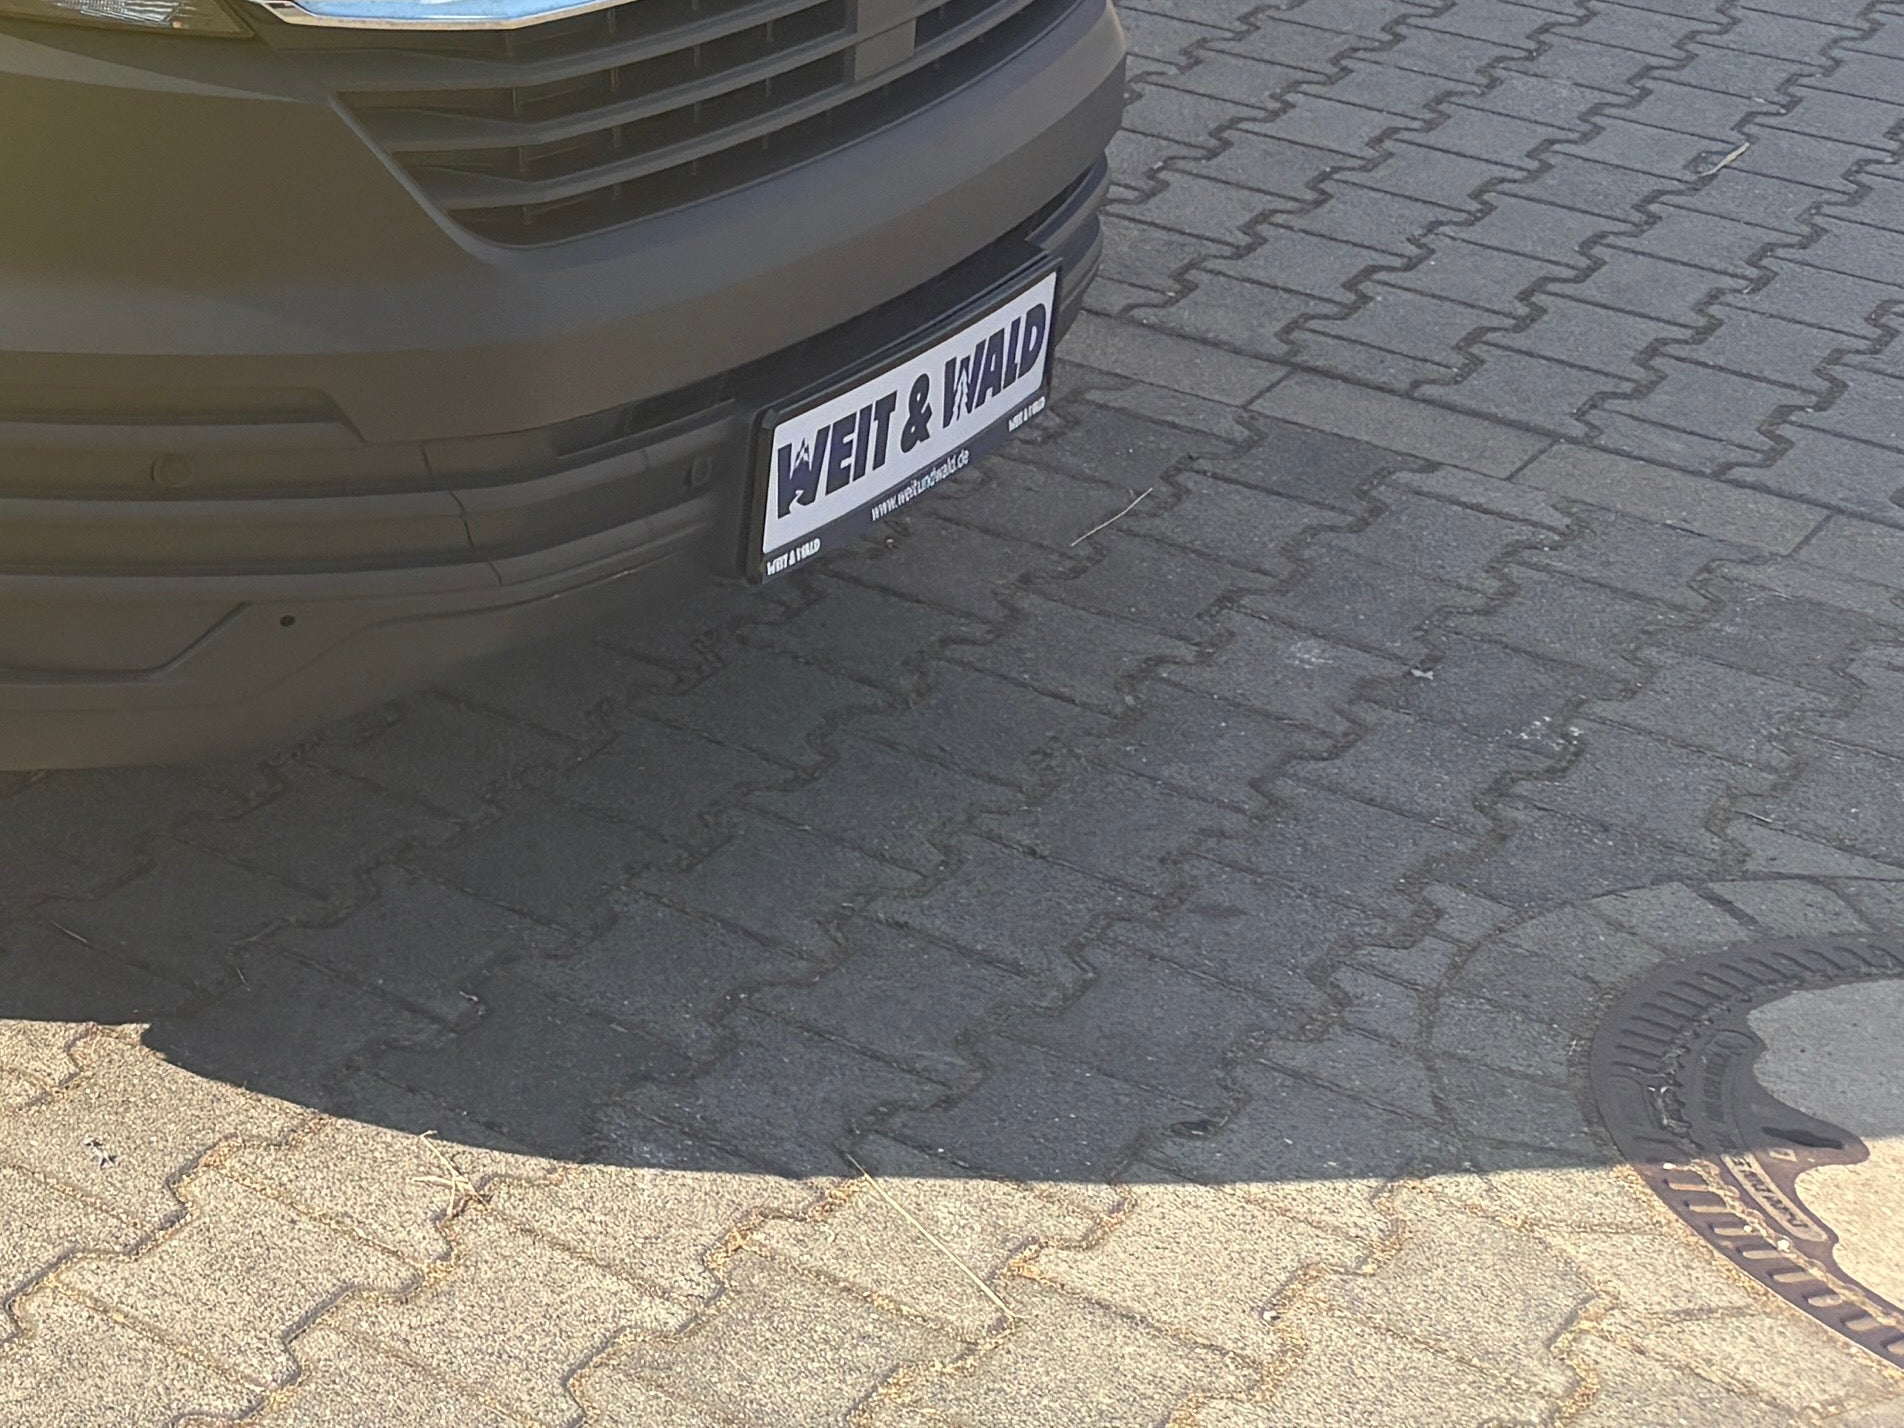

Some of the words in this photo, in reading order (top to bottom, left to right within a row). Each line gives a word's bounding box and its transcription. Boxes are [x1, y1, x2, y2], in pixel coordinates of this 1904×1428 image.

[777, 390, 898, 520] WEIT
[900, 373, 933, 453] &
[942, 303, 1047, 430] WALD
